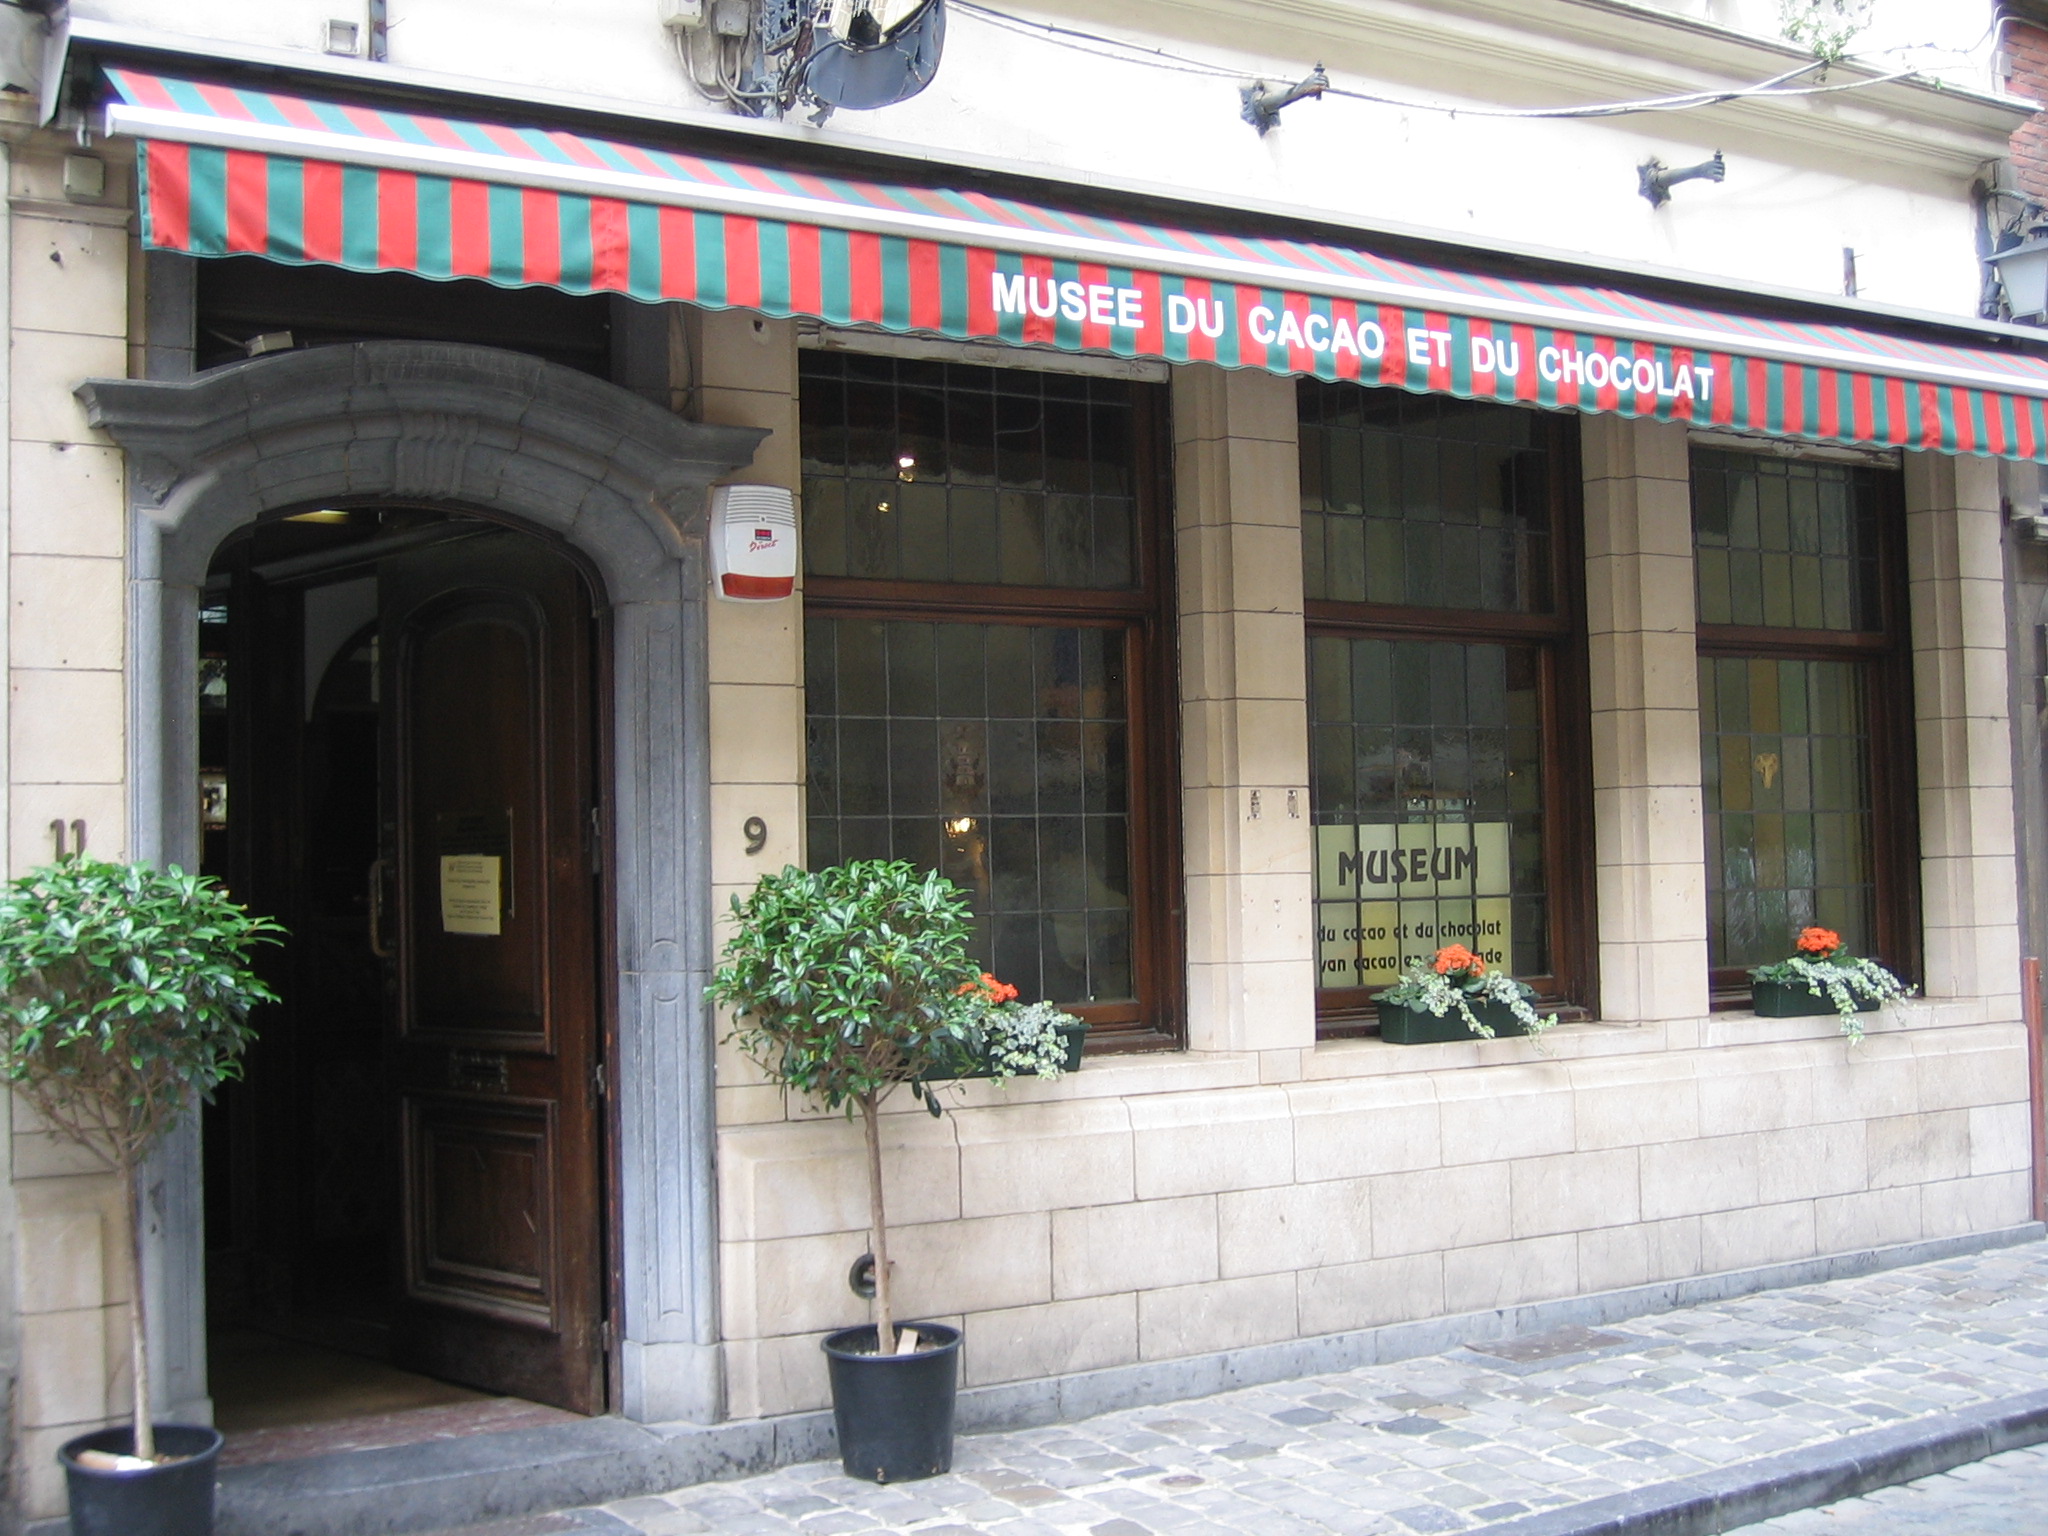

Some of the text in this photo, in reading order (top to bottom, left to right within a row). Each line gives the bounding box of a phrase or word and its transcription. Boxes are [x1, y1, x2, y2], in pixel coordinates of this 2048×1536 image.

[991, 273, 1716, 402] MUSEE DU CACAO ET DU CHOCOLAT
[50, 818, 86, 863] 11
[743, 816, 767, 856] 9
[1338, 846, 1478, 886] MUSEUM
[1318, 919, 1502, 942] du cacao et du chocolat
[1321, 958, 1346, 973] van
[1354, 956, 1397, 970] cacao
